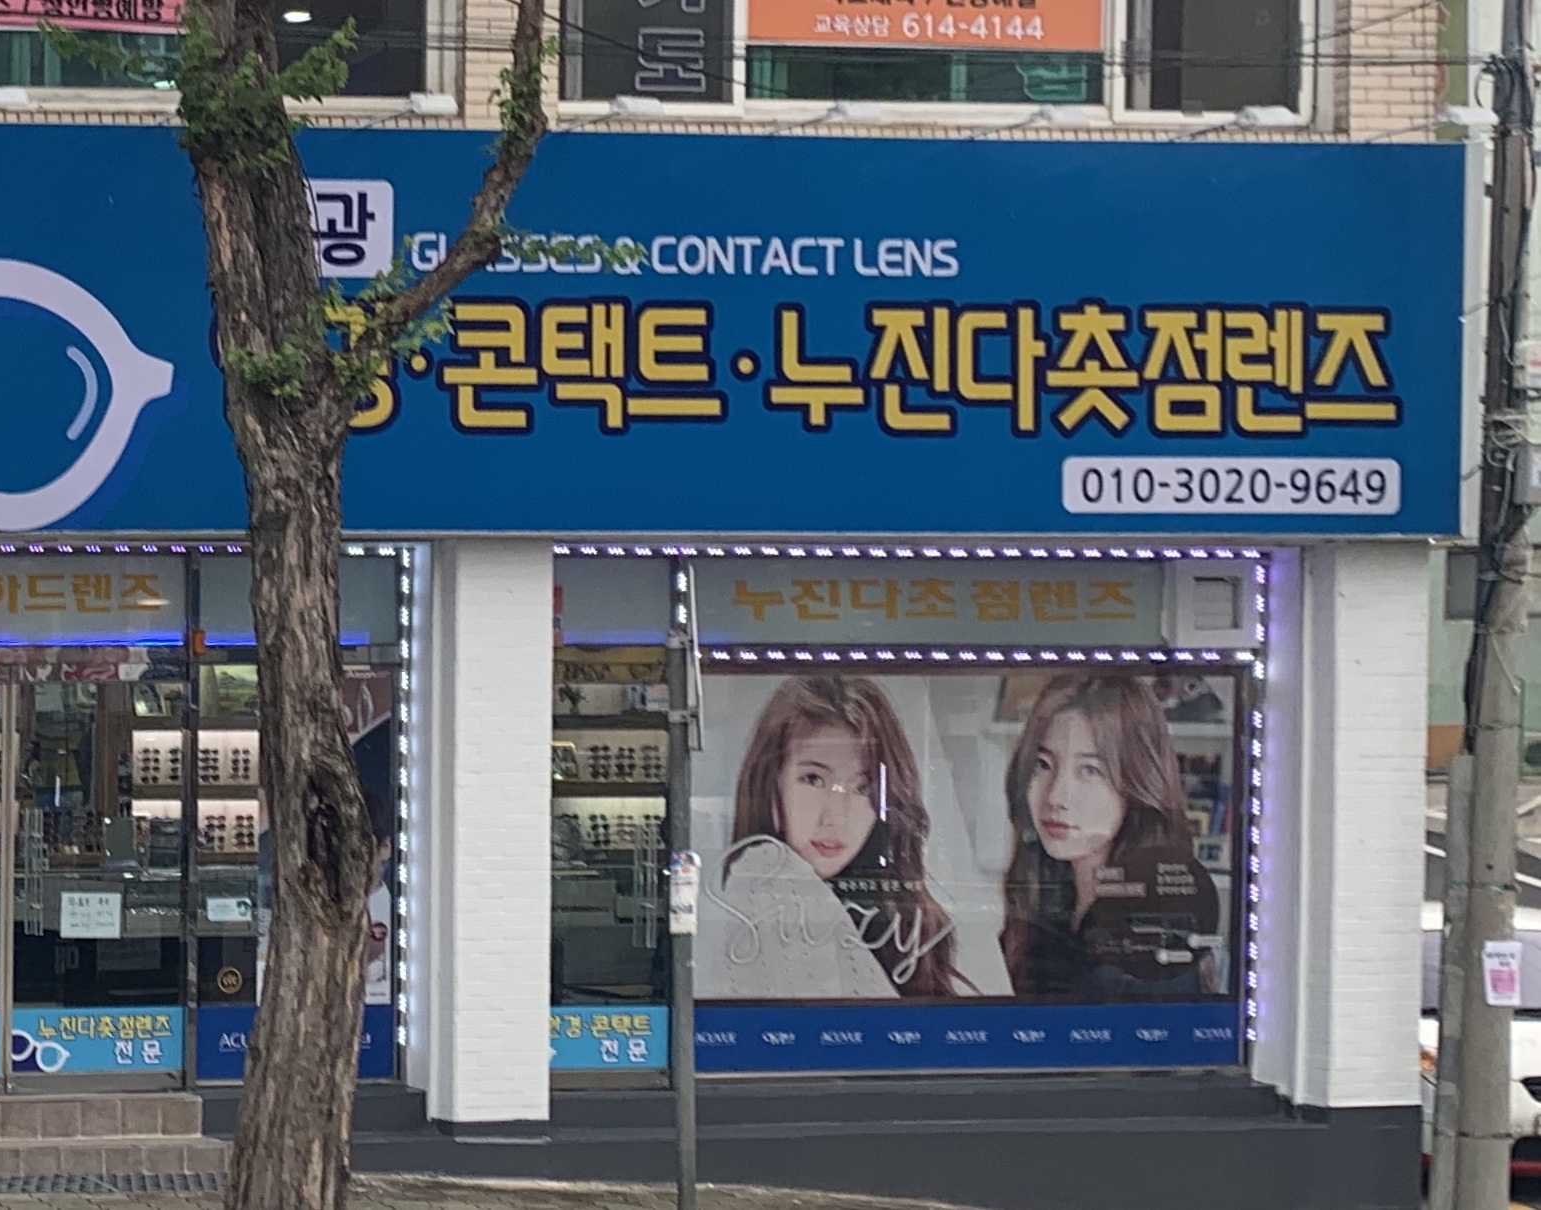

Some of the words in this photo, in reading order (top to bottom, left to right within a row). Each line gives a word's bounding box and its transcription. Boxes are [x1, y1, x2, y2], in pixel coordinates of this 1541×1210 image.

[814, 13, 892, 37] 교육상담
[902, 12, 1046, 40] 614-4144
[651, 234, 845, 277] CONTACT
[852, 237, 959, 278] LENS
[1081, 466, 1387, 505] 010-3020-9649
